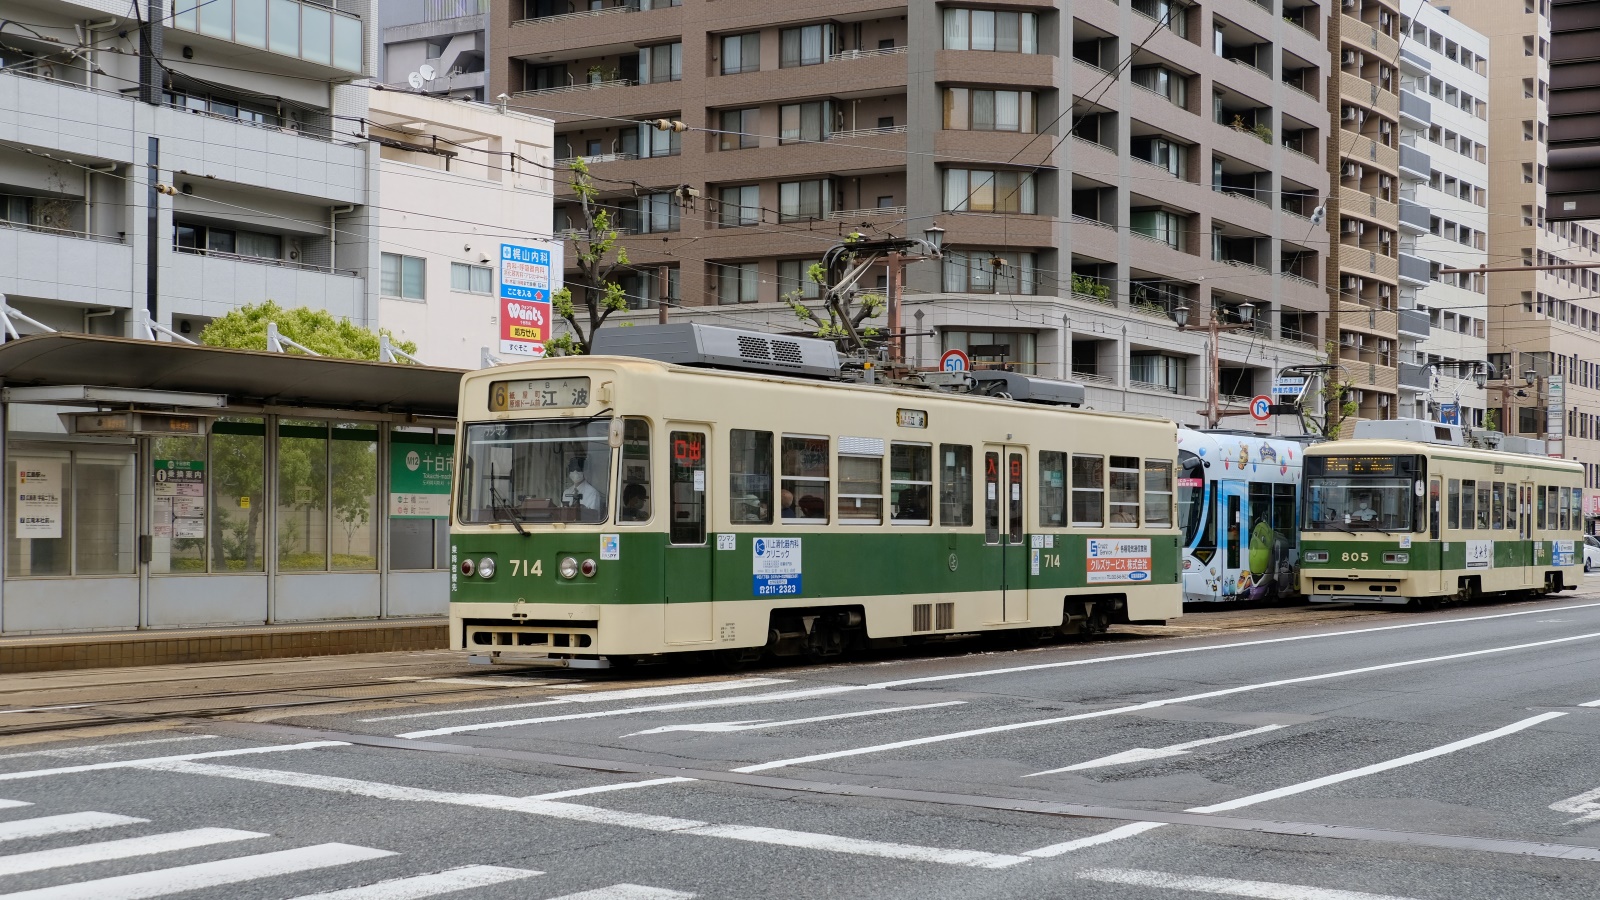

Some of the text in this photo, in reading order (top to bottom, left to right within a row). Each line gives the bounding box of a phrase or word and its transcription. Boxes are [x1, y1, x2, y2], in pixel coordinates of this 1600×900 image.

[513, 248, 548, 264] 梶山内科
[507, 288, 532, 298] ここを入る
[508, 303, 544, 326] Wants
[515, 328, 537, 338] 処方せん
[509, 344, 528, 352] すぐそこ
[946, 358, 963, 371] 50
[496, 386, 504, 406] 6
[509, 390, 541, 399] 紙屋町
[542, 388, 588, 406] 江波
[407, 456, 419, 466] M12
[168, 470, 202, 478] 乗換案内
[766, 540, 798, 548] 川上消化器内科
[766, 550, 790, 558] クリニック
[1342, 552, 1369, 562] 805
[1044, 554, 1060, 568] 714
[1090, 559, 1148, 570] クルズサービス 株式会社
[510, 560, 542, 576] 714
